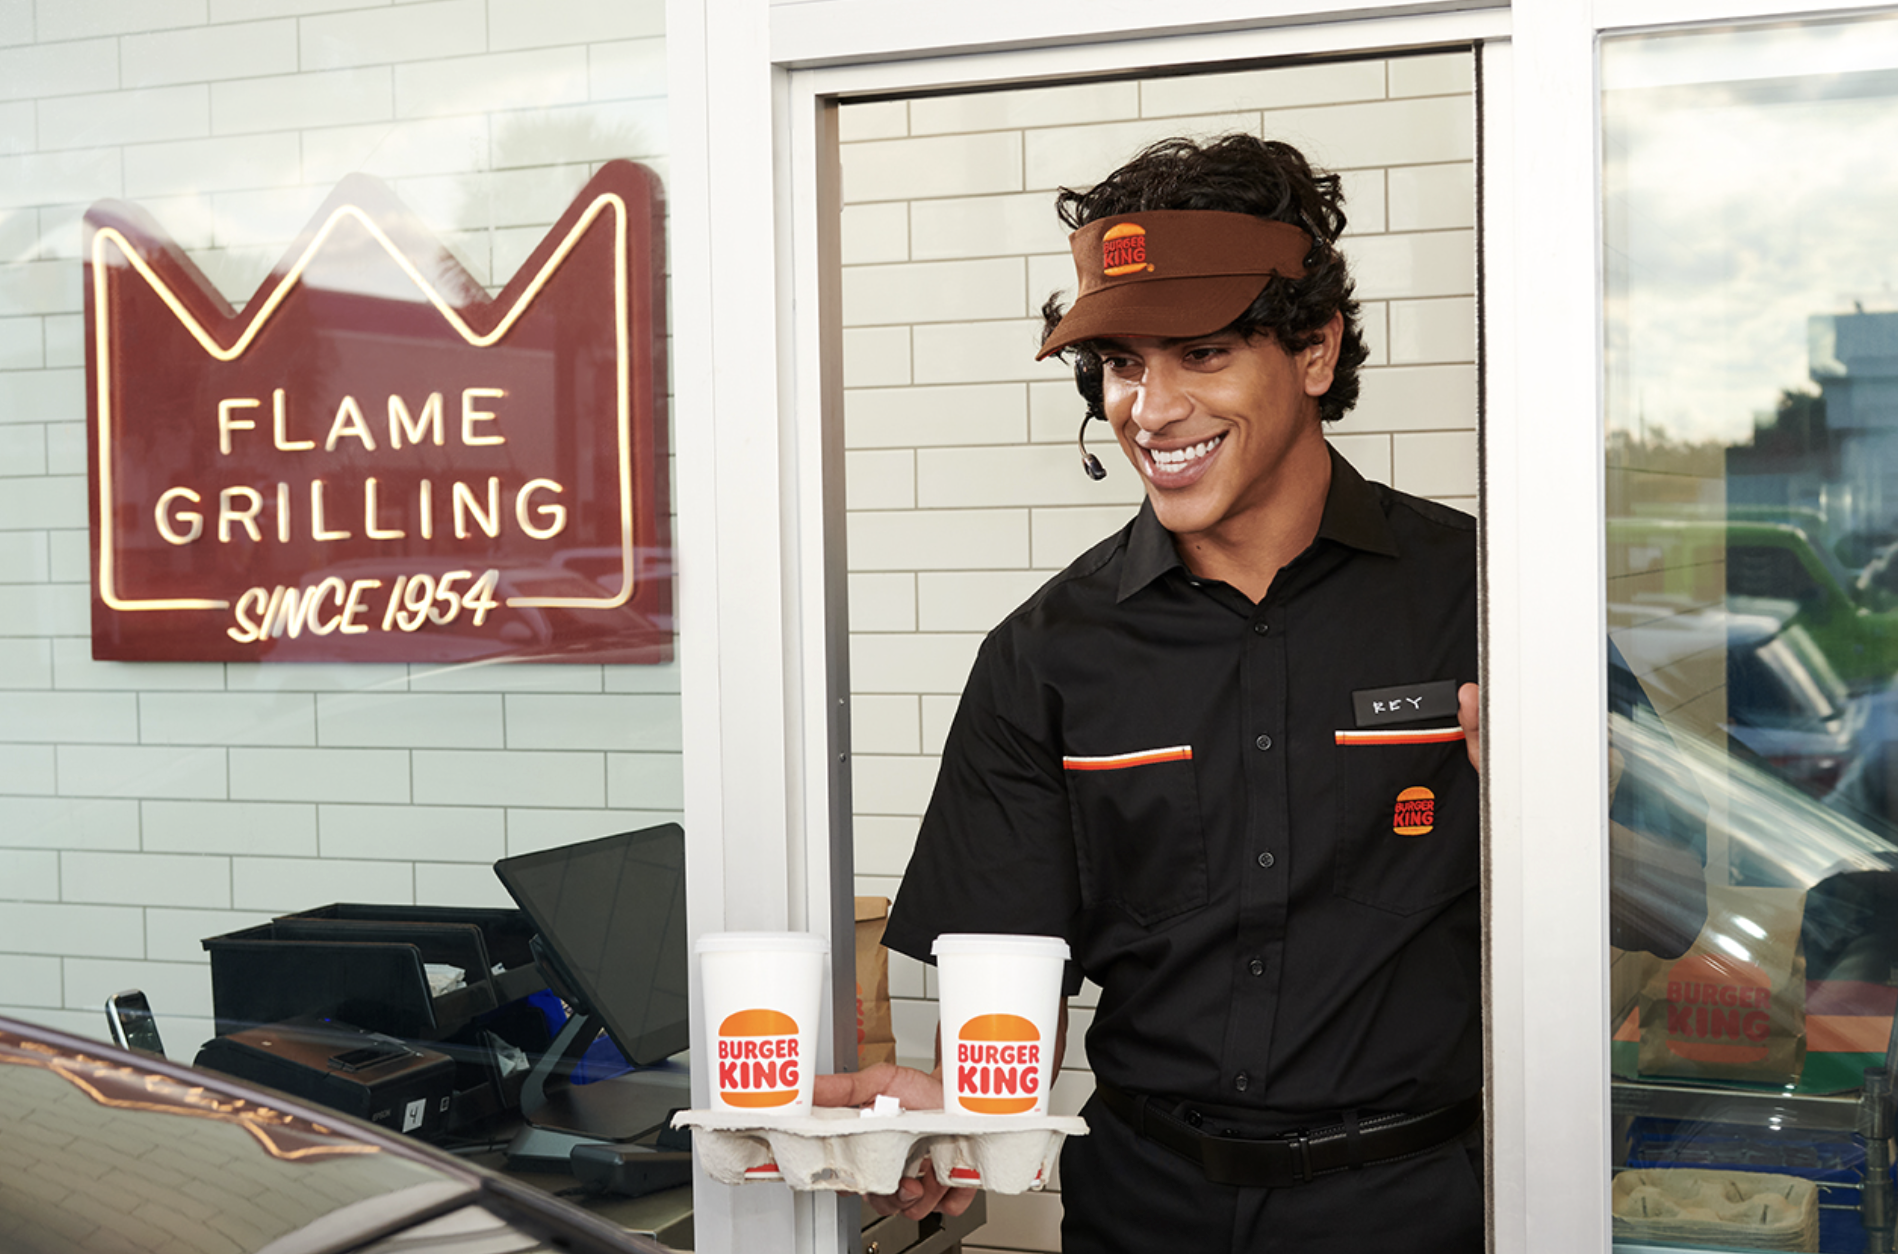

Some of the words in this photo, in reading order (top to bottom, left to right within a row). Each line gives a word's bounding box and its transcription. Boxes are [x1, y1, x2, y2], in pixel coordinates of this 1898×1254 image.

[1104, 236, 1145, 253] BURGER
[1104, 248, 1145, 268] KING
[218, 388, 506, 455] FLAME
[154, 476, 568, 545] GRILLING
[227, 576, 382, 643] SINCE
[382, 569, 499, 632] 1954
[1373, 696, 1422, 714] REY
[1395, 800, 1434, 813] BURGER
[1393, 811, 1434, 827] KING
[1666, 981, 1771, 1009] BURGER
[1667, 1004, 1771, 1042] KING
[718, 1038, 799, 1060] BURGER
[958, 1043, 1039, 1065] BURGER
[719, 1060, 799, 1090] KING
[958, 1065, 1039, 1095] KING
[409, 1106, 418, 1124] 4
